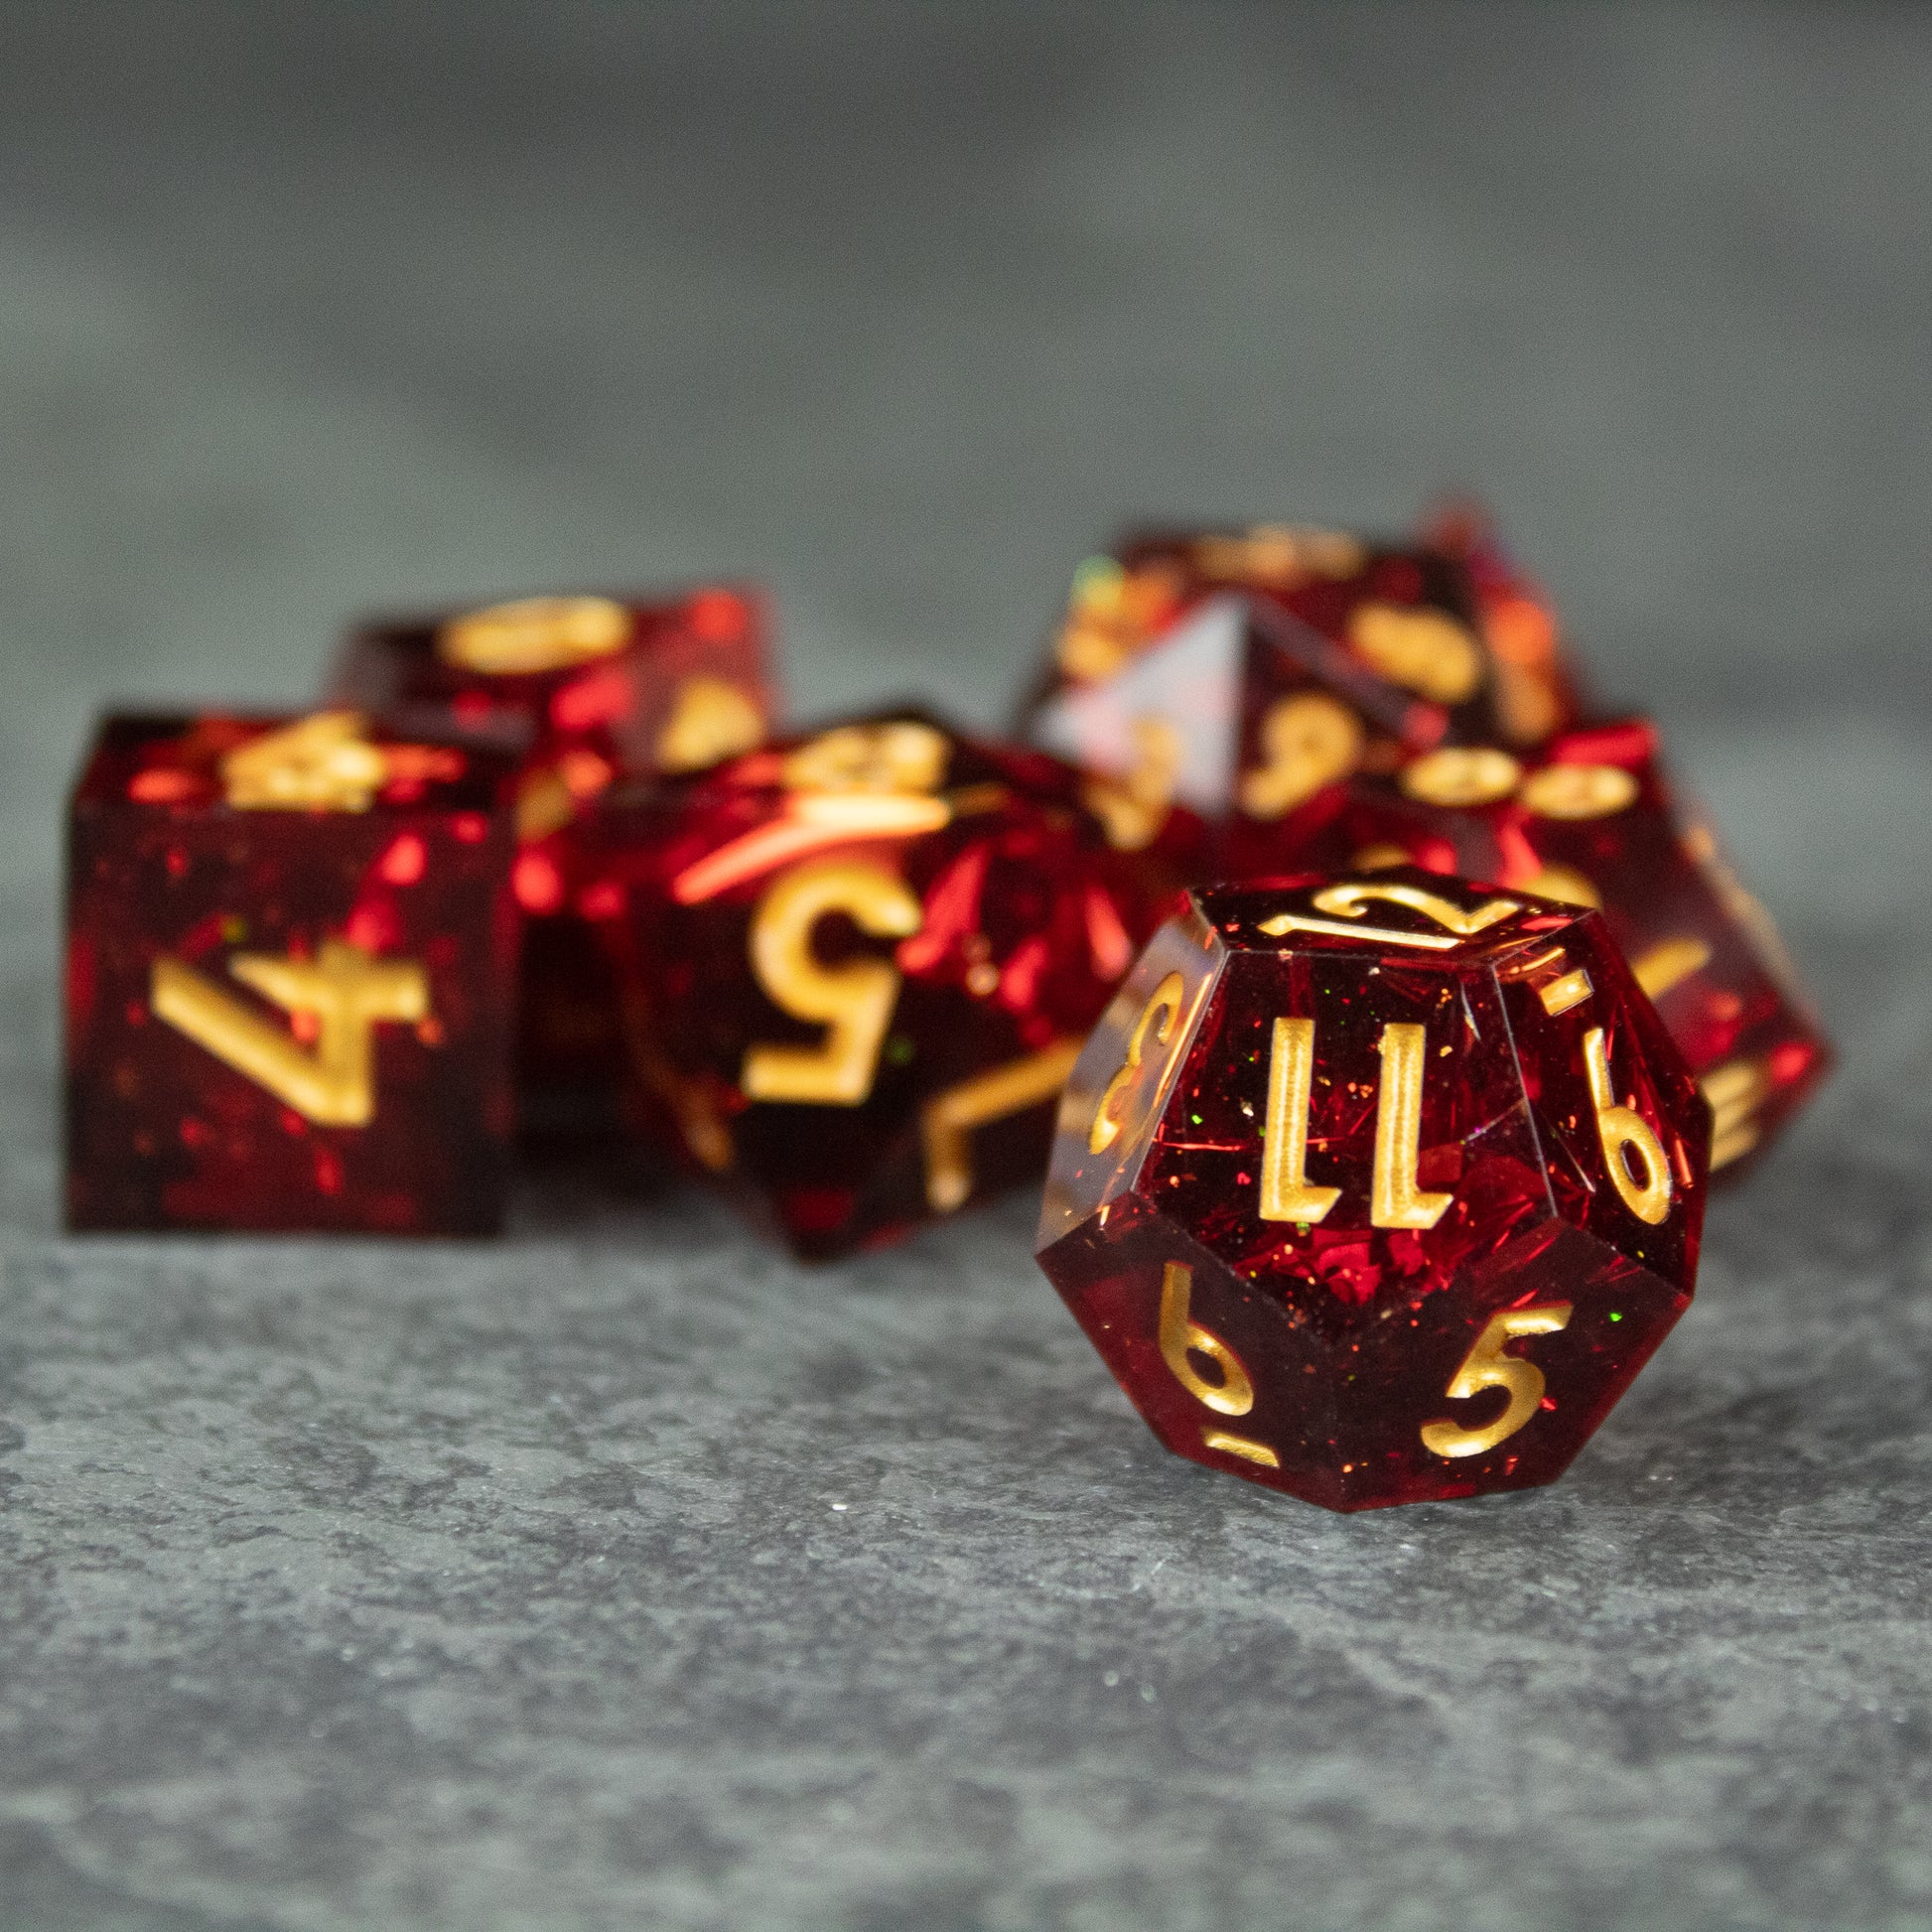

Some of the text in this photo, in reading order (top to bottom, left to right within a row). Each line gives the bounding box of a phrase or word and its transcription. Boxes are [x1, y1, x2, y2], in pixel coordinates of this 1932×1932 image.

[744, 862, 923, 1108] 5
[1257, 884, 1524, 950] 12
[151, 941, 430, 1129] 4
[1259, 1016, 1454, 1230] 11
[1421, 1301, 1574, 1459] 5
